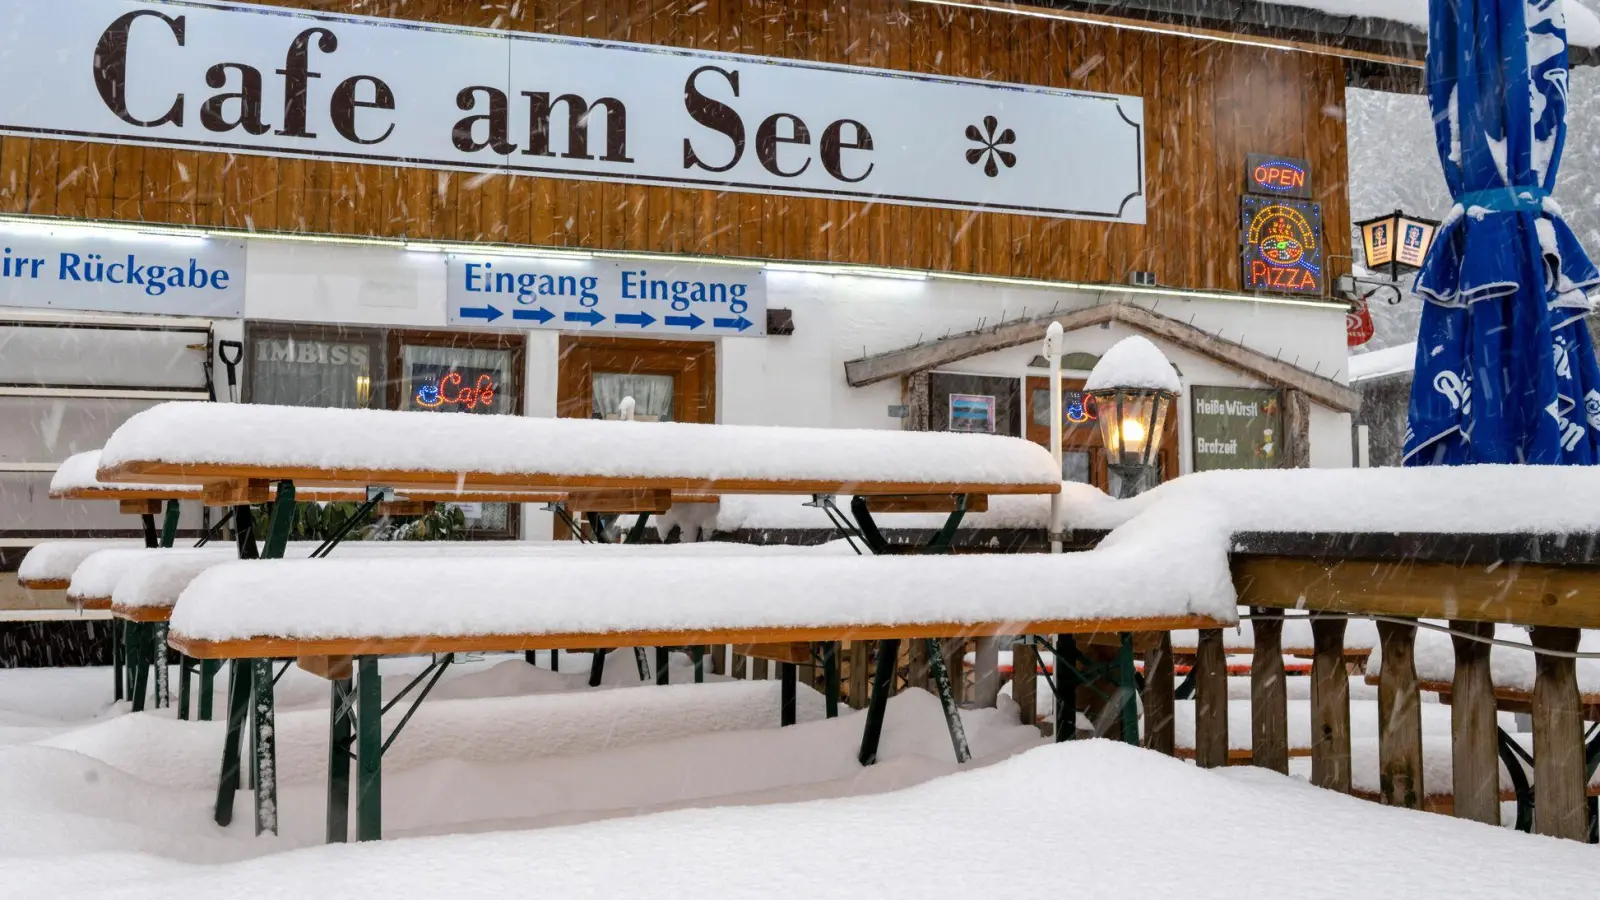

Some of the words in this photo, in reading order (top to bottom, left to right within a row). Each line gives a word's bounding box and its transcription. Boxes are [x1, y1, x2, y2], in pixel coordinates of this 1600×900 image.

[93, 9, 396, 145] Cafe
[451, 85, 635, 163] am
[683, 65, 875, 183] See
[1254, 166, 1305, 187] OPEN
[58, 252, 230, 296] Rückgabe
[464, 262, 599, 308] Eingang
[621, 271, 749, 313] Eingang
[1251, 260, 1316, 289] PIZZA
[256, 340, 369, 366] IMBISS
[439, 372, 494, 409] Café
[1196, 399, 1225, 415] Heiße
[1225, 400, 1258, 416] Würstl
[1197, 436, 1237, 454] Brotzeit
